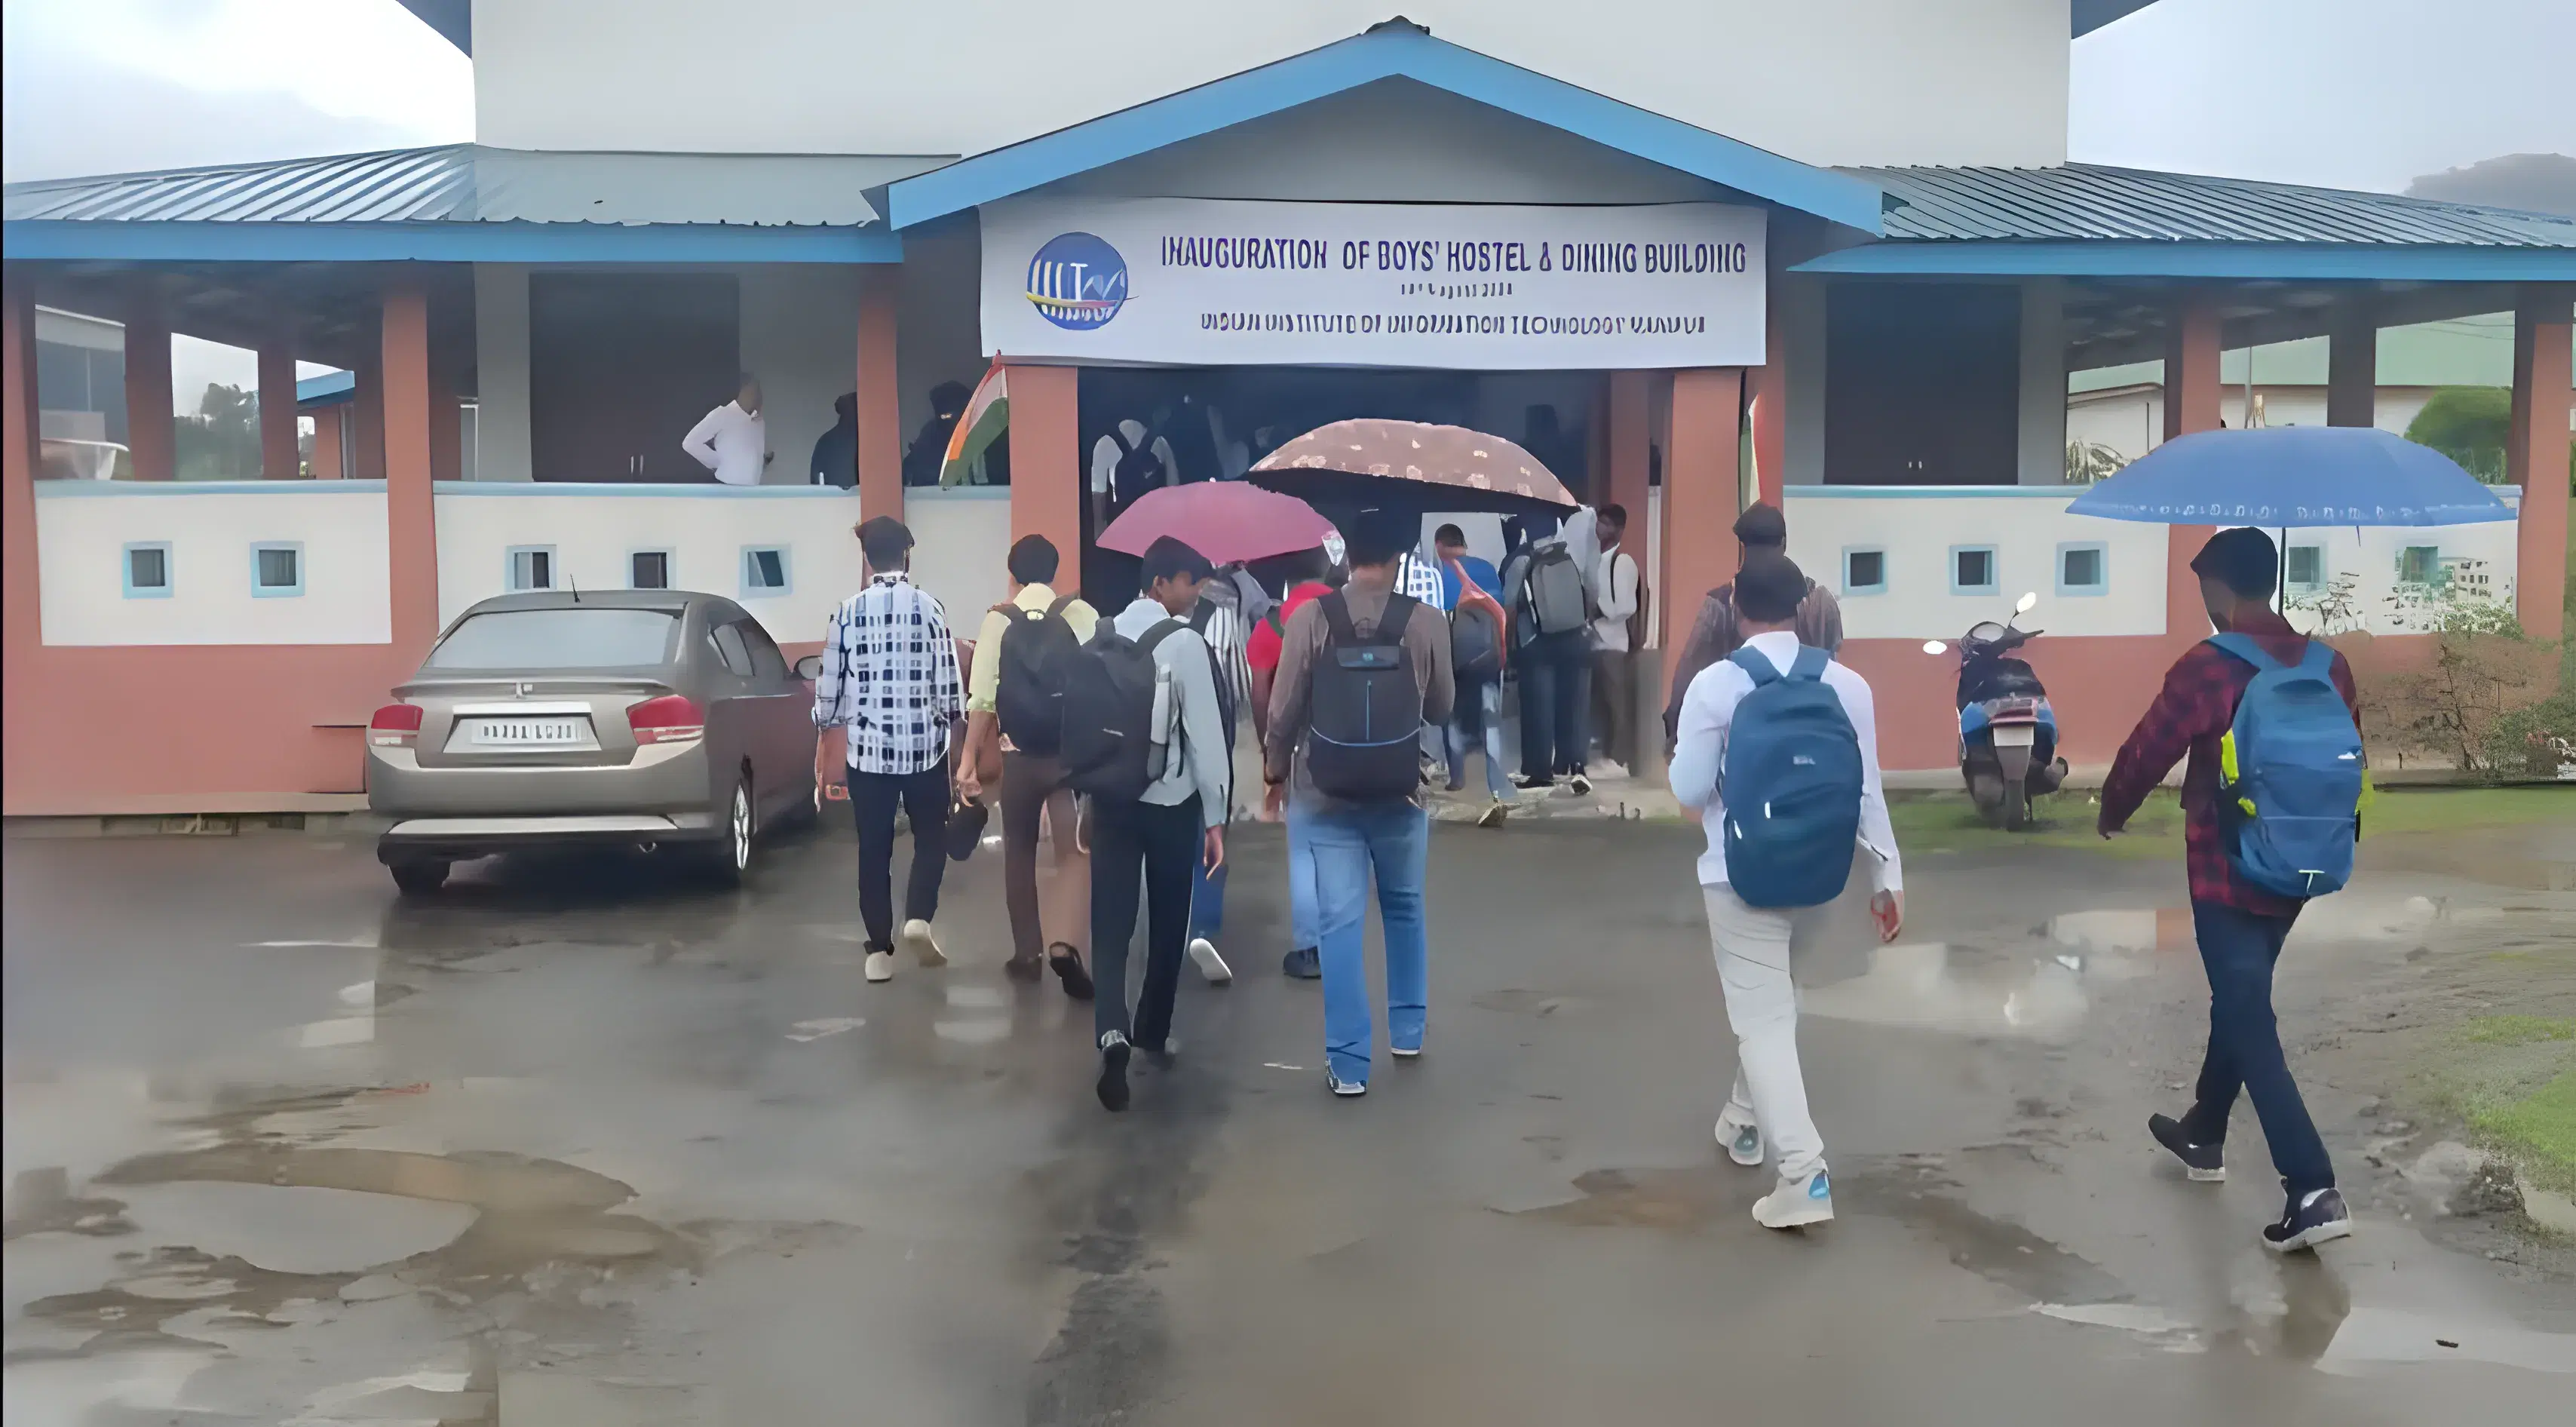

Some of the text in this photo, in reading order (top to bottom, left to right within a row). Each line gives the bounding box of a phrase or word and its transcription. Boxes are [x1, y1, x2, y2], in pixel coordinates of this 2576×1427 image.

[1161, 235, 1328, 270] INAUGURATION
[1342, 240, 1371, 270] OF
[1447, 241, 1532, 273] HOSTEL
[1562, 242, 1638, 274] DINING
[1645, 242, 1746, 274] BUILDING
